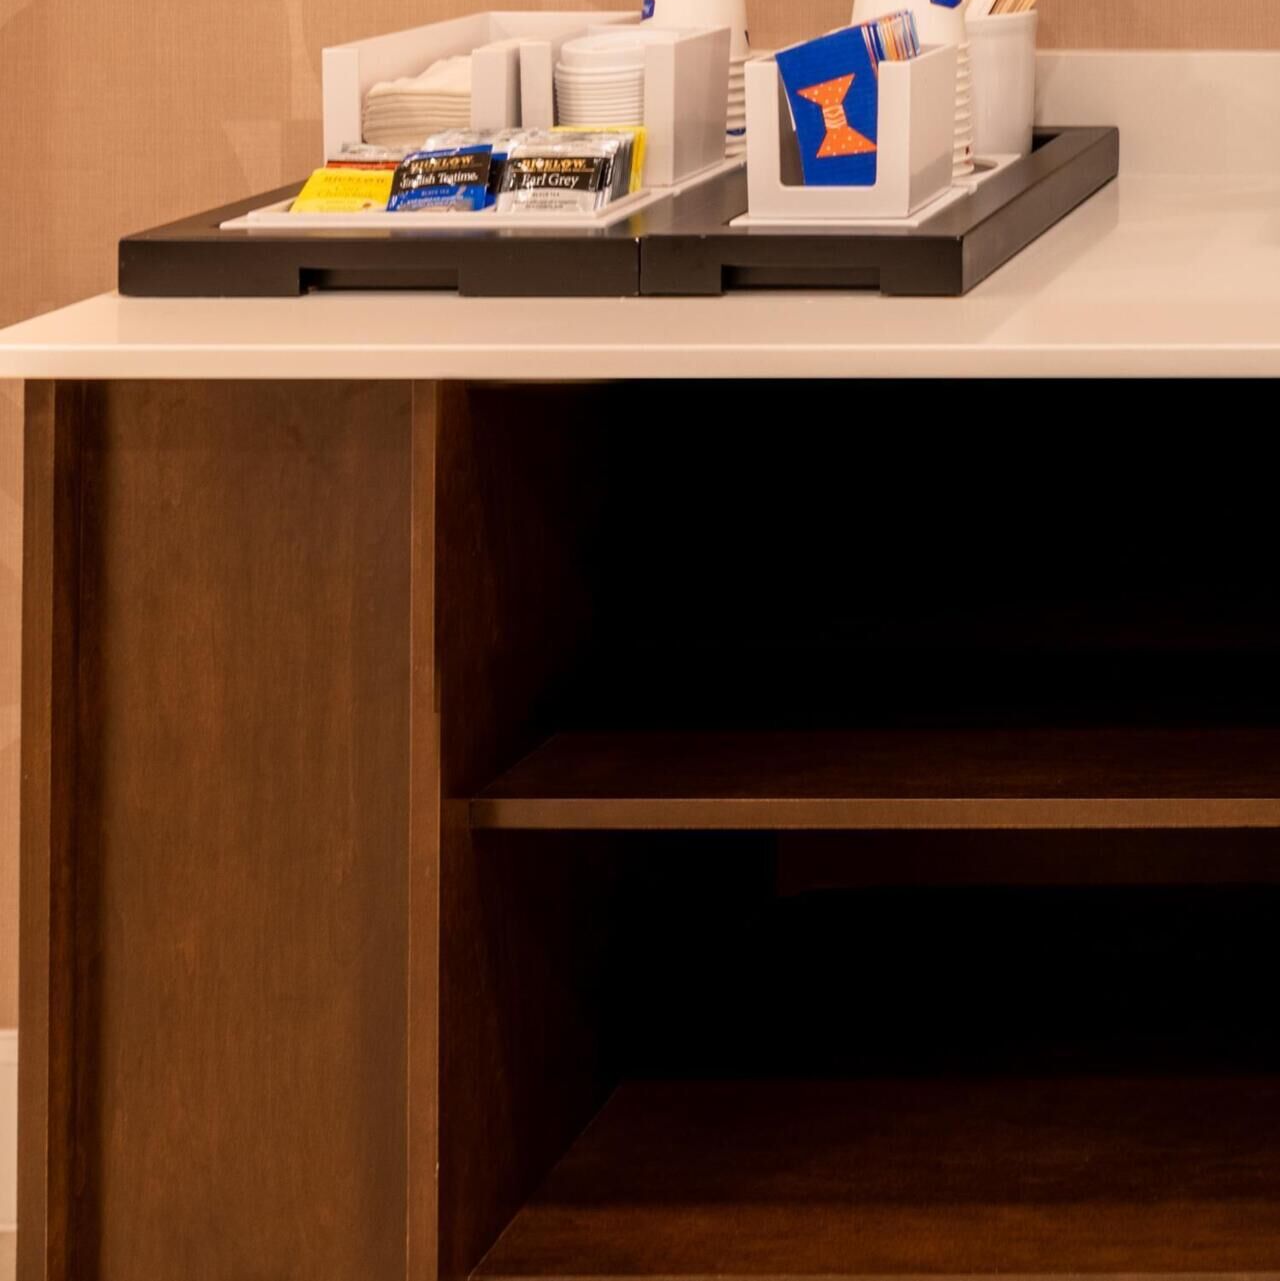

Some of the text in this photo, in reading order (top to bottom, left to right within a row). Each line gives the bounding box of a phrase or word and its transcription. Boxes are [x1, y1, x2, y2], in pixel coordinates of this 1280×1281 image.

[521, 159, 586, 170] BIELOW
[522, 173, 579, 189] Earl Grey
